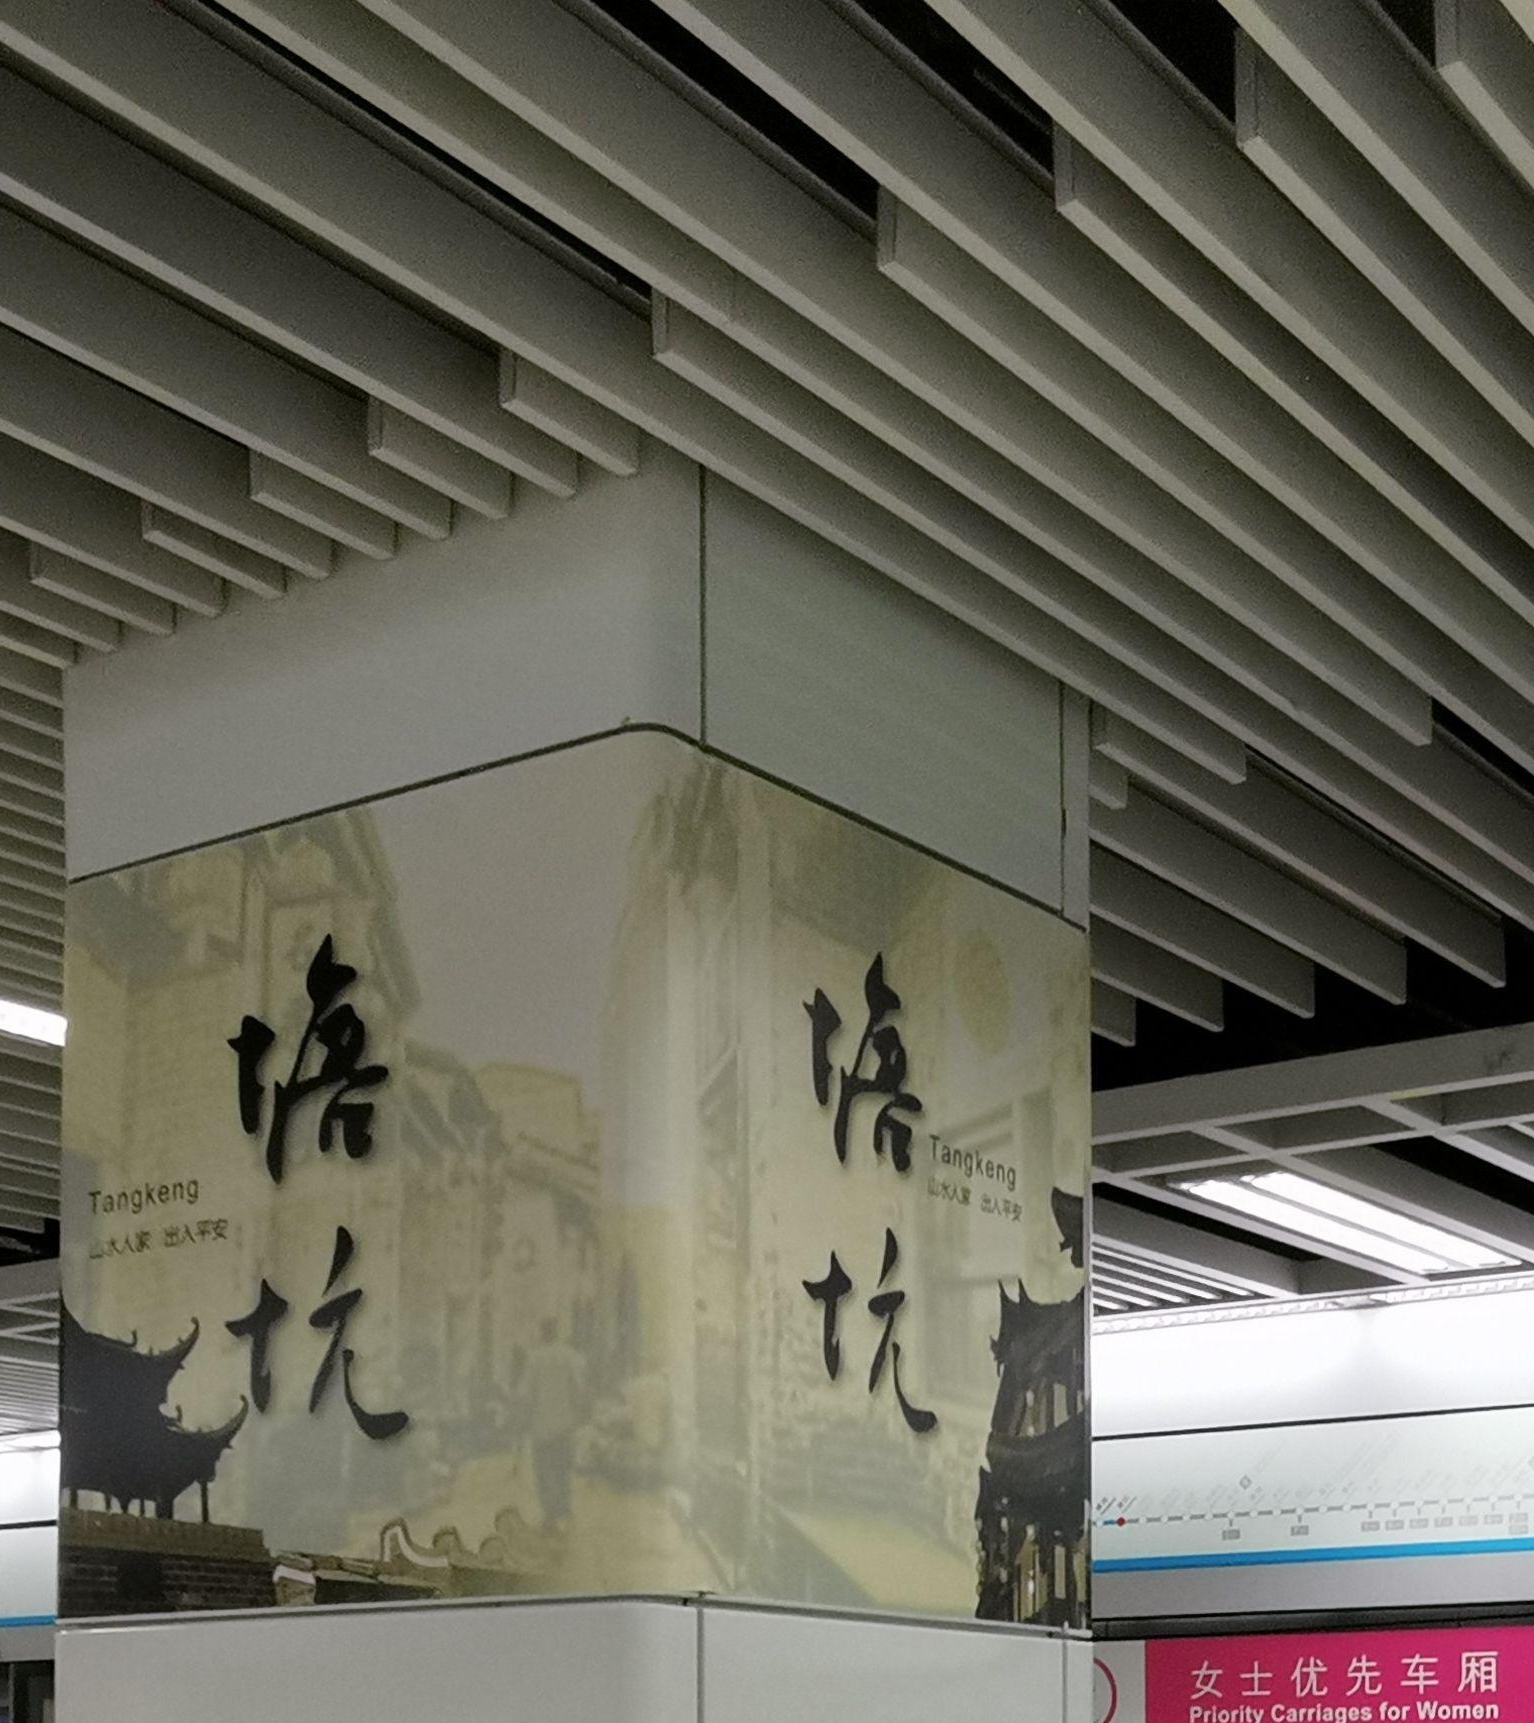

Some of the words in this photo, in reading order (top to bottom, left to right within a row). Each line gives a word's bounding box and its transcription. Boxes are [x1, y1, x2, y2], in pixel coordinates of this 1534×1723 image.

[929, 1133, 1016, 1192] Tangkeng
[87, 1179, 199, 1215] Tangkeng
[1189, 1650, 1499, 1700] 女士优先车厢
[1379, 1700, 1411, 1721] for
[1416, 1700, 1500, 1721] Women
